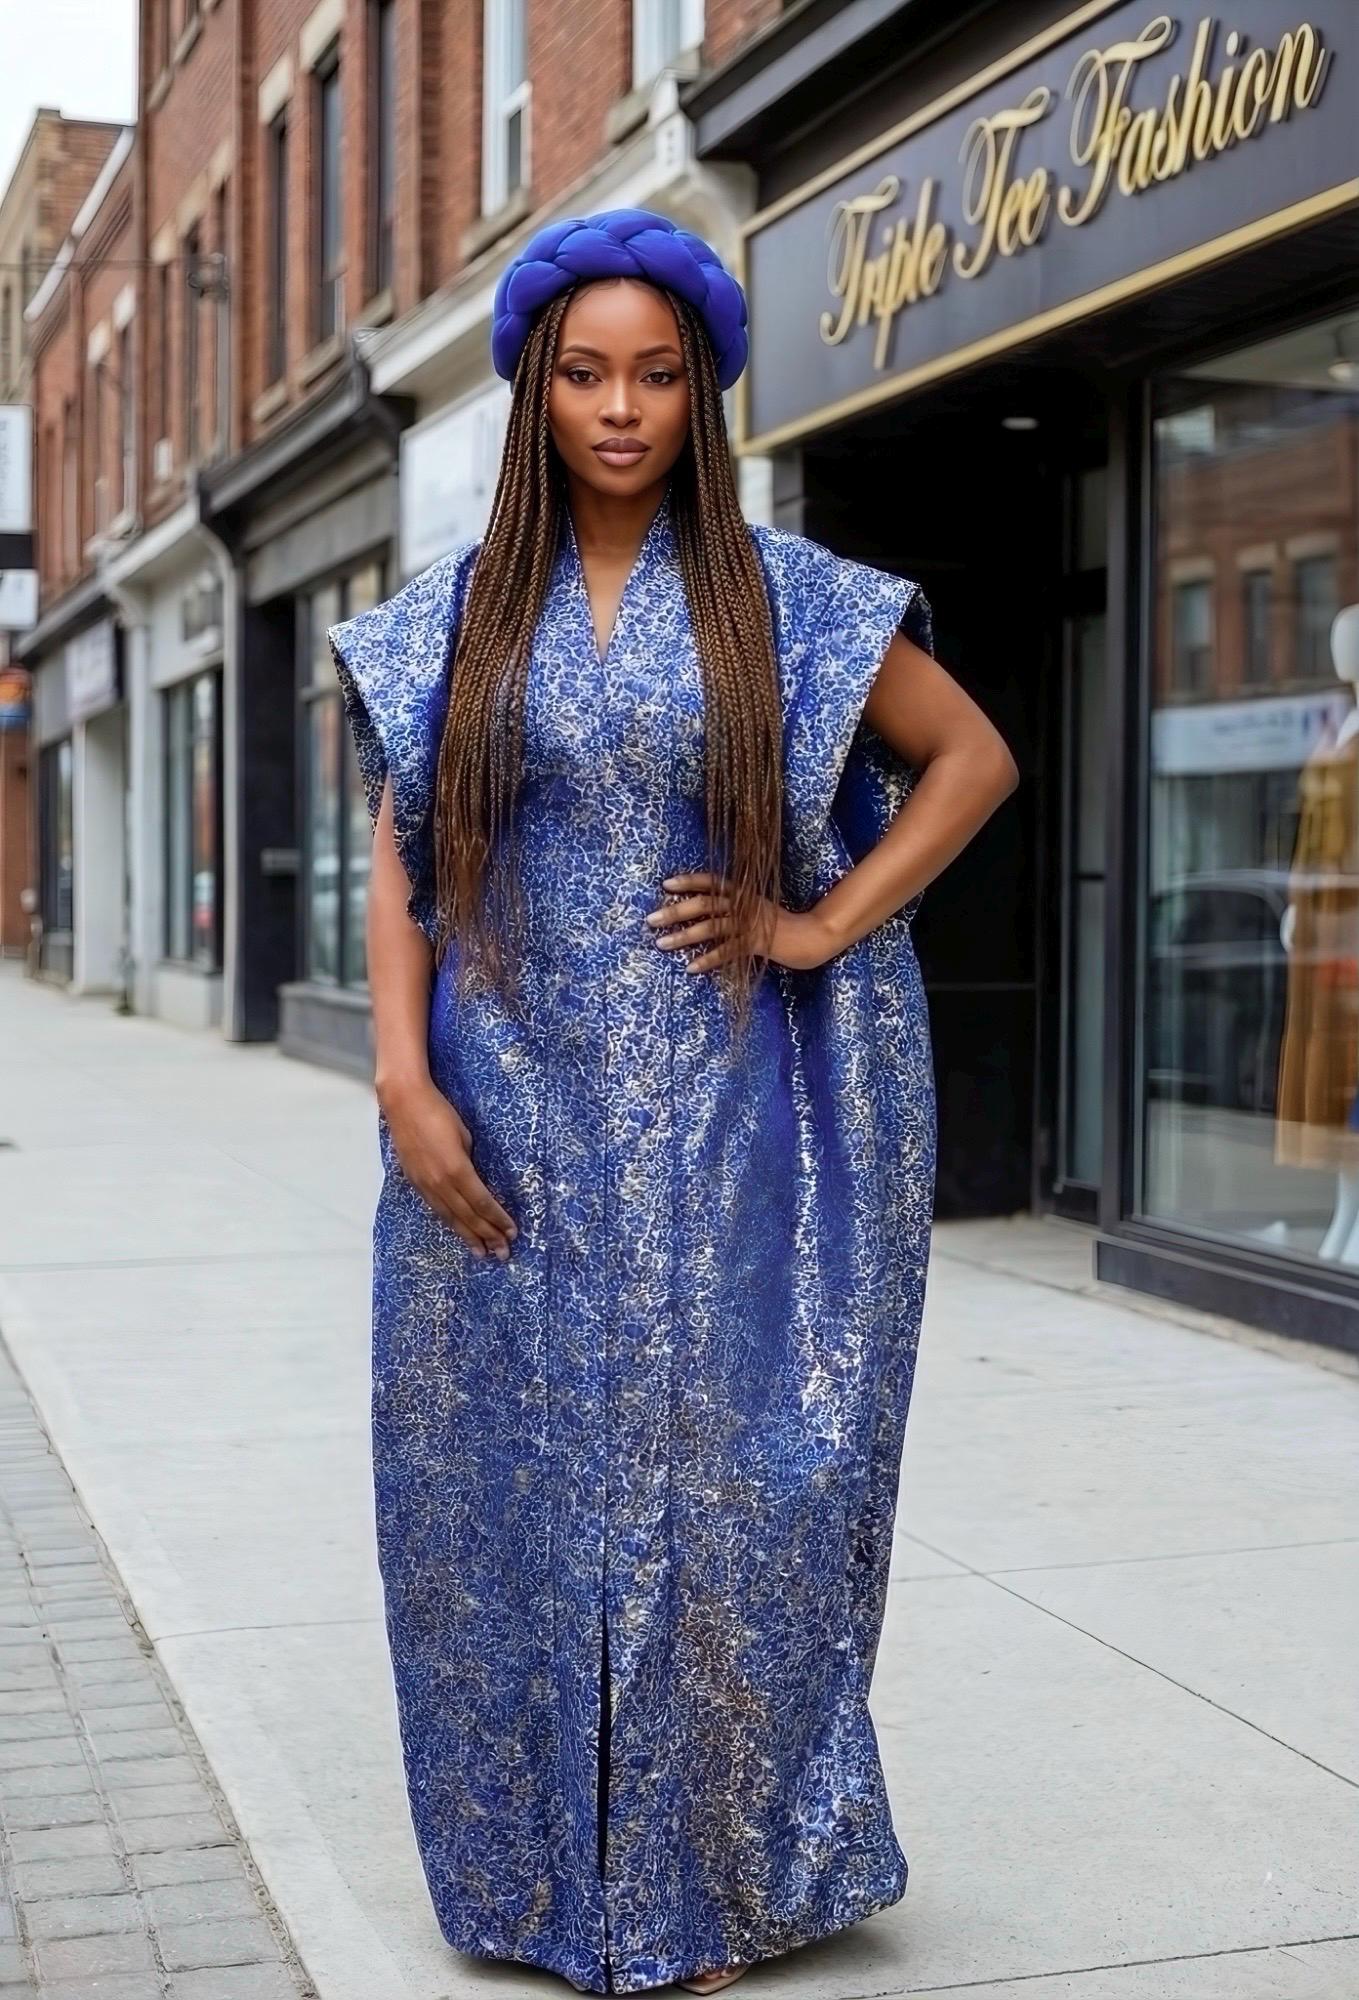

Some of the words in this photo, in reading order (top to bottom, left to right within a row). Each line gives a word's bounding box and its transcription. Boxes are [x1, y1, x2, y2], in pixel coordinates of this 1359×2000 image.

[820, 176, 946, 370] Triple
[953, 86, 1051, 279] Tee
[1058, 15, 1326, 226] Fashion
